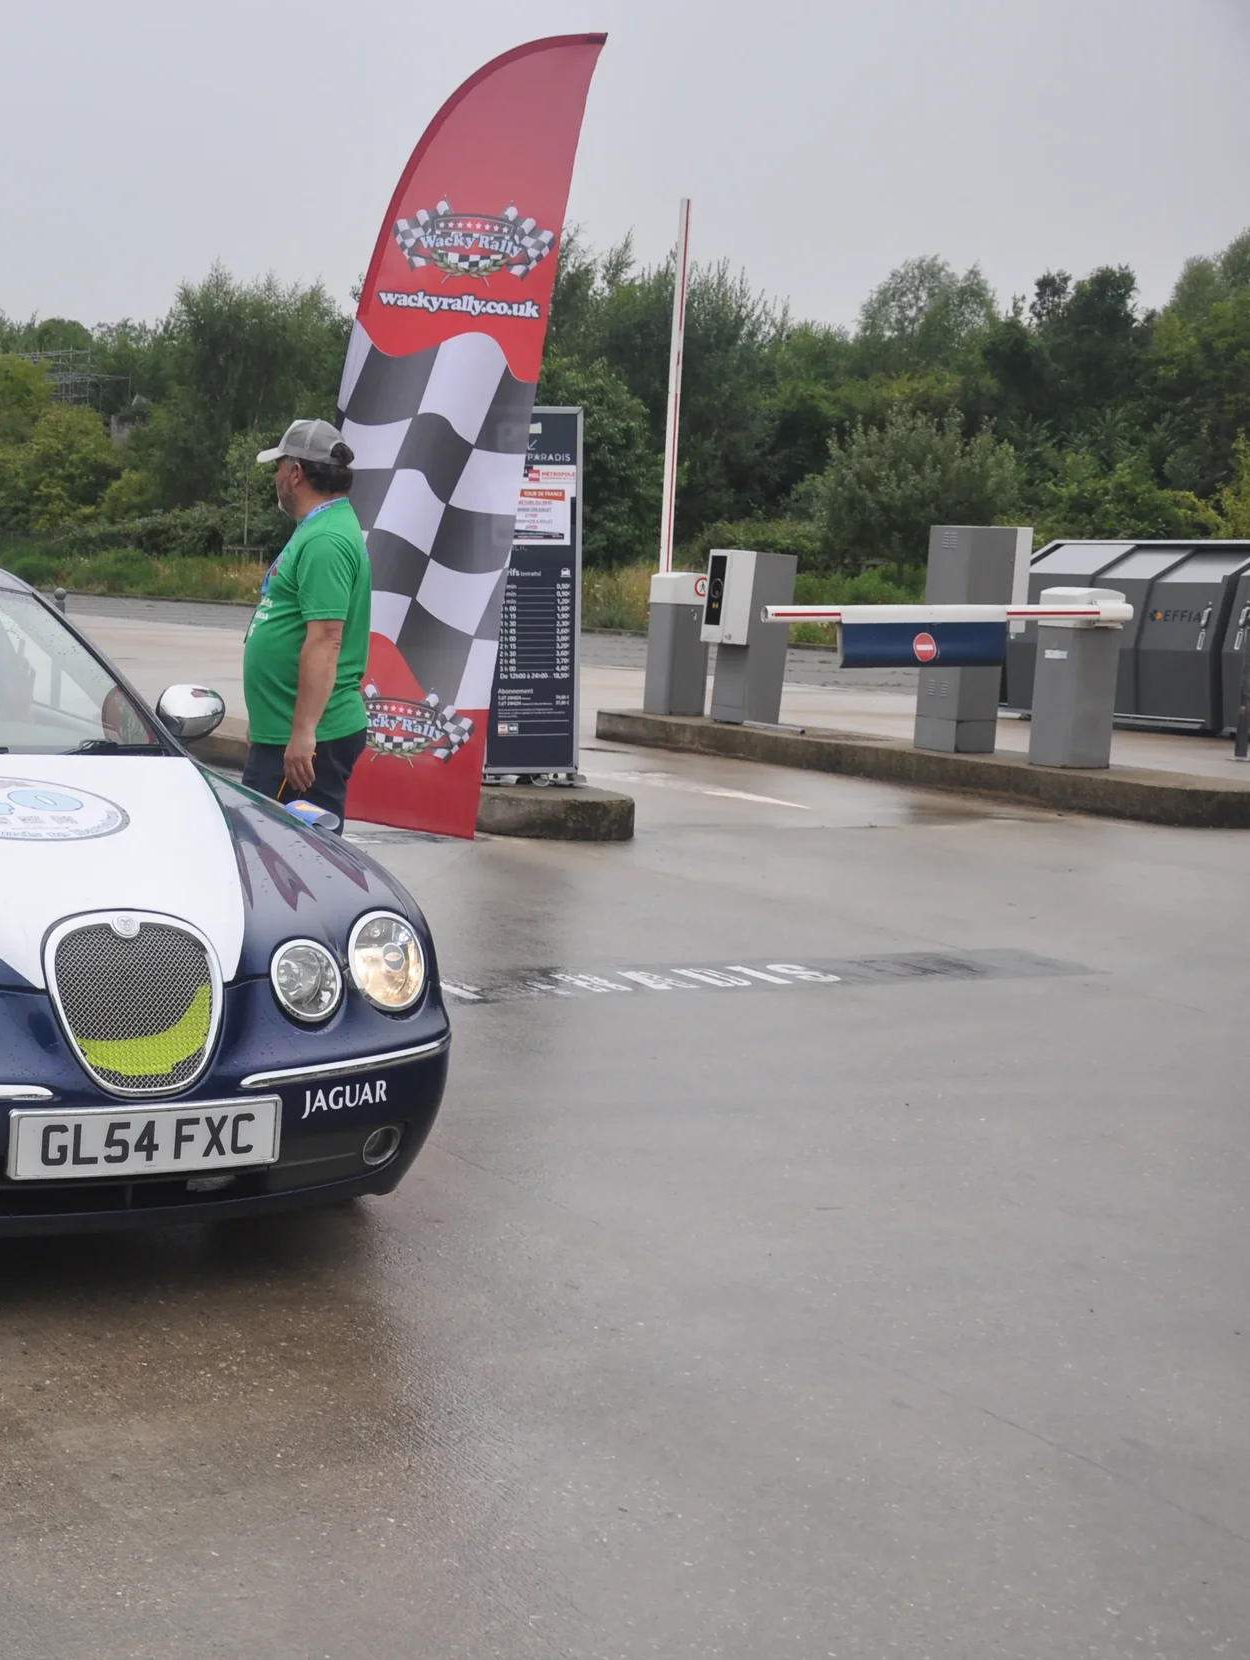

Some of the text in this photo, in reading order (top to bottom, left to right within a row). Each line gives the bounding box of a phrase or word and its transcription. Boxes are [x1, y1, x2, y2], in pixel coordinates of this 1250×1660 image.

[420, 232, 522, 258] Wacky Rally
[378, 291, 540, 318] wackyrally.co.uk
[528, 452, 571, 462] PARADIS
[1164, 610, 1200, 623] EFFIA
[367, 714, 444, 742] cky Rally
[440, 964, 842, 999] PRADIS
[301, 1079, 388, 1119] JAGUAR
[40, 1112, 256, 1166] GL54 FXC
